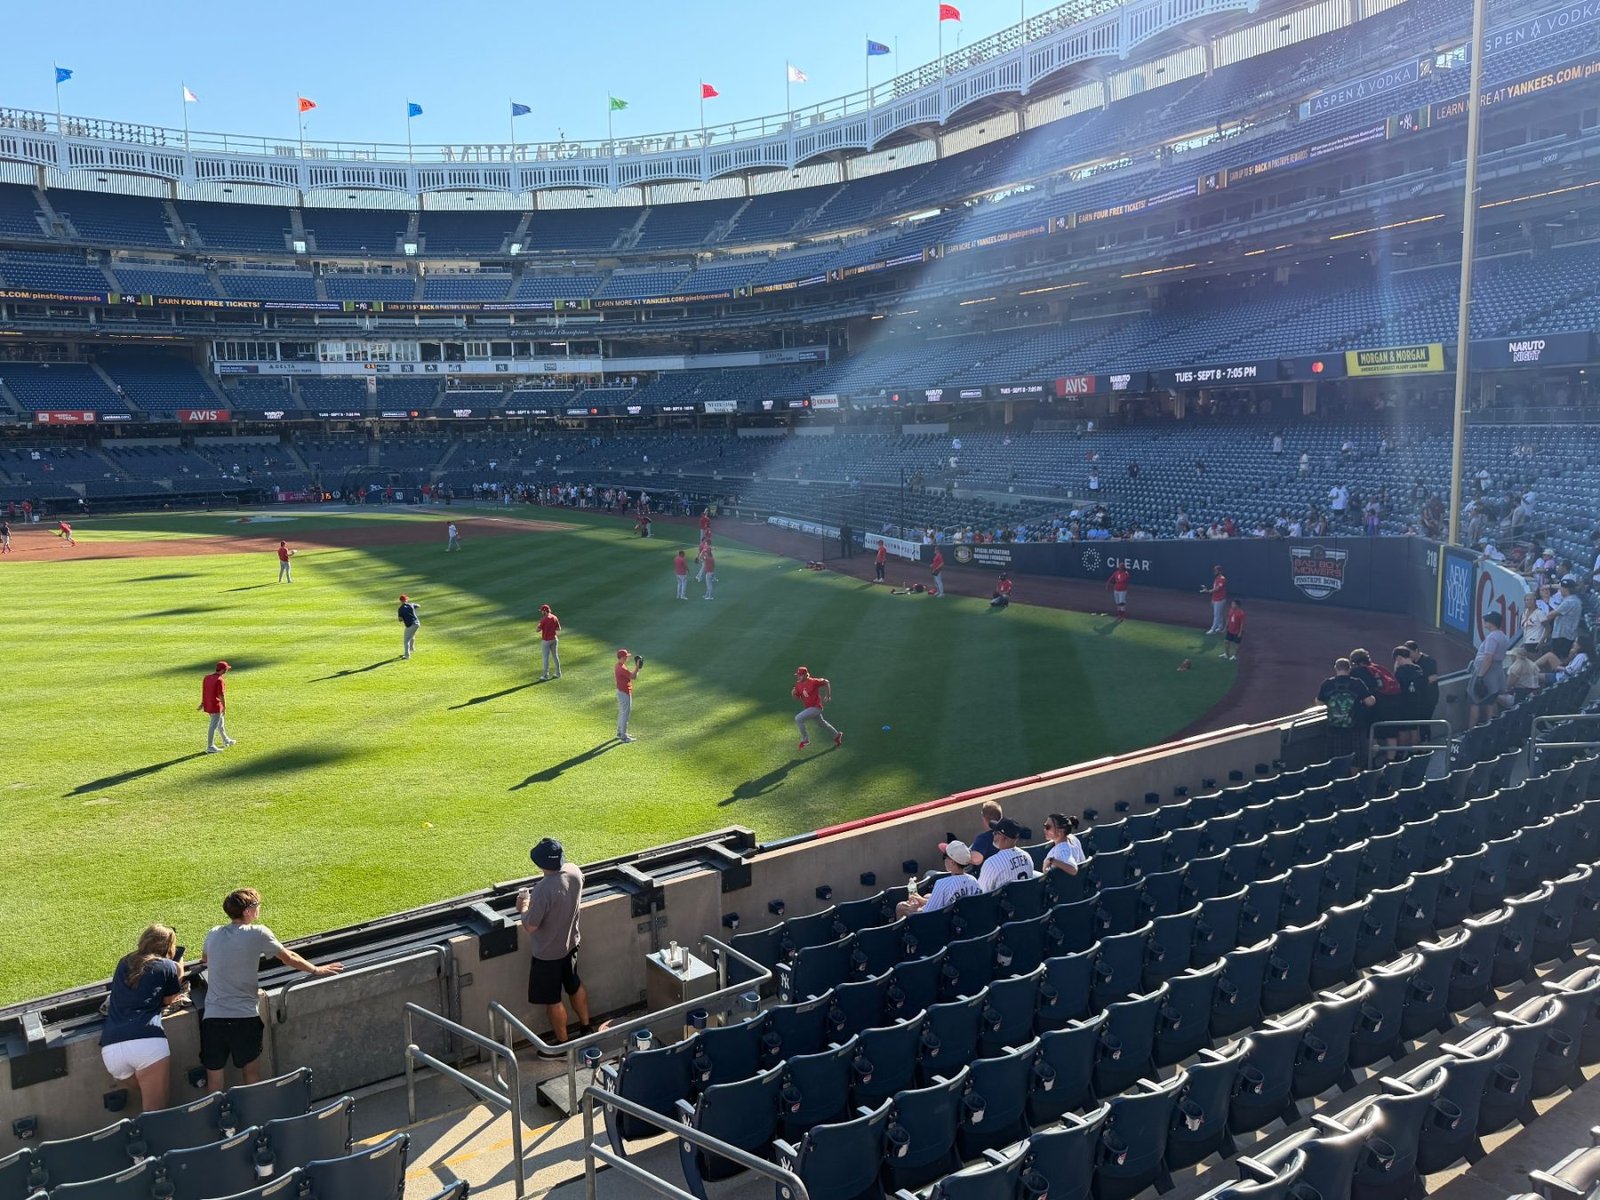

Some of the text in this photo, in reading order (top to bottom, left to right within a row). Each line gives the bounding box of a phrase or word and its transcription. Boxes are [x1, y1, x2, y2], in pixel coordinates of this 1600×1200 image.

[1484, 27, 1525, 52] SPEN
[1315, 68, 1411, 111] ASPEN VODKA
[1436, 101, 1464, 120] LEARN
[1493, 88, 1505, 102] AT
[1508, 339, 1545, 353] NARUTO
[1360, 348, 1426, 365] MORGAN & MORGAN
[1513, 350, 1541, 362] NIGHT
[1175, 371, 1193, 383] TUES
[1197, 369, 1216, 381] SEPT
[1216, 369, 1221, 379] 8
[1227, 366, 1243, 378] 7:05
[1244, 366, 1256, 377] PM
[1065, 378, 1088, 394] AVIS
[189, 411, 217, 421] AVIS
[1107, 557, 1150, 571] CLEAR
[1294, 559, 1342, 569] BAD BOY
[1295, 566, 1342, 576] MOWERS
[1450, 564, 1469, 585] NEW
[1446, 578, 1469, 605] YORK
[1448, 602, 1465, 622] LIFE
[1009, 855, 1028, 871] JETER
